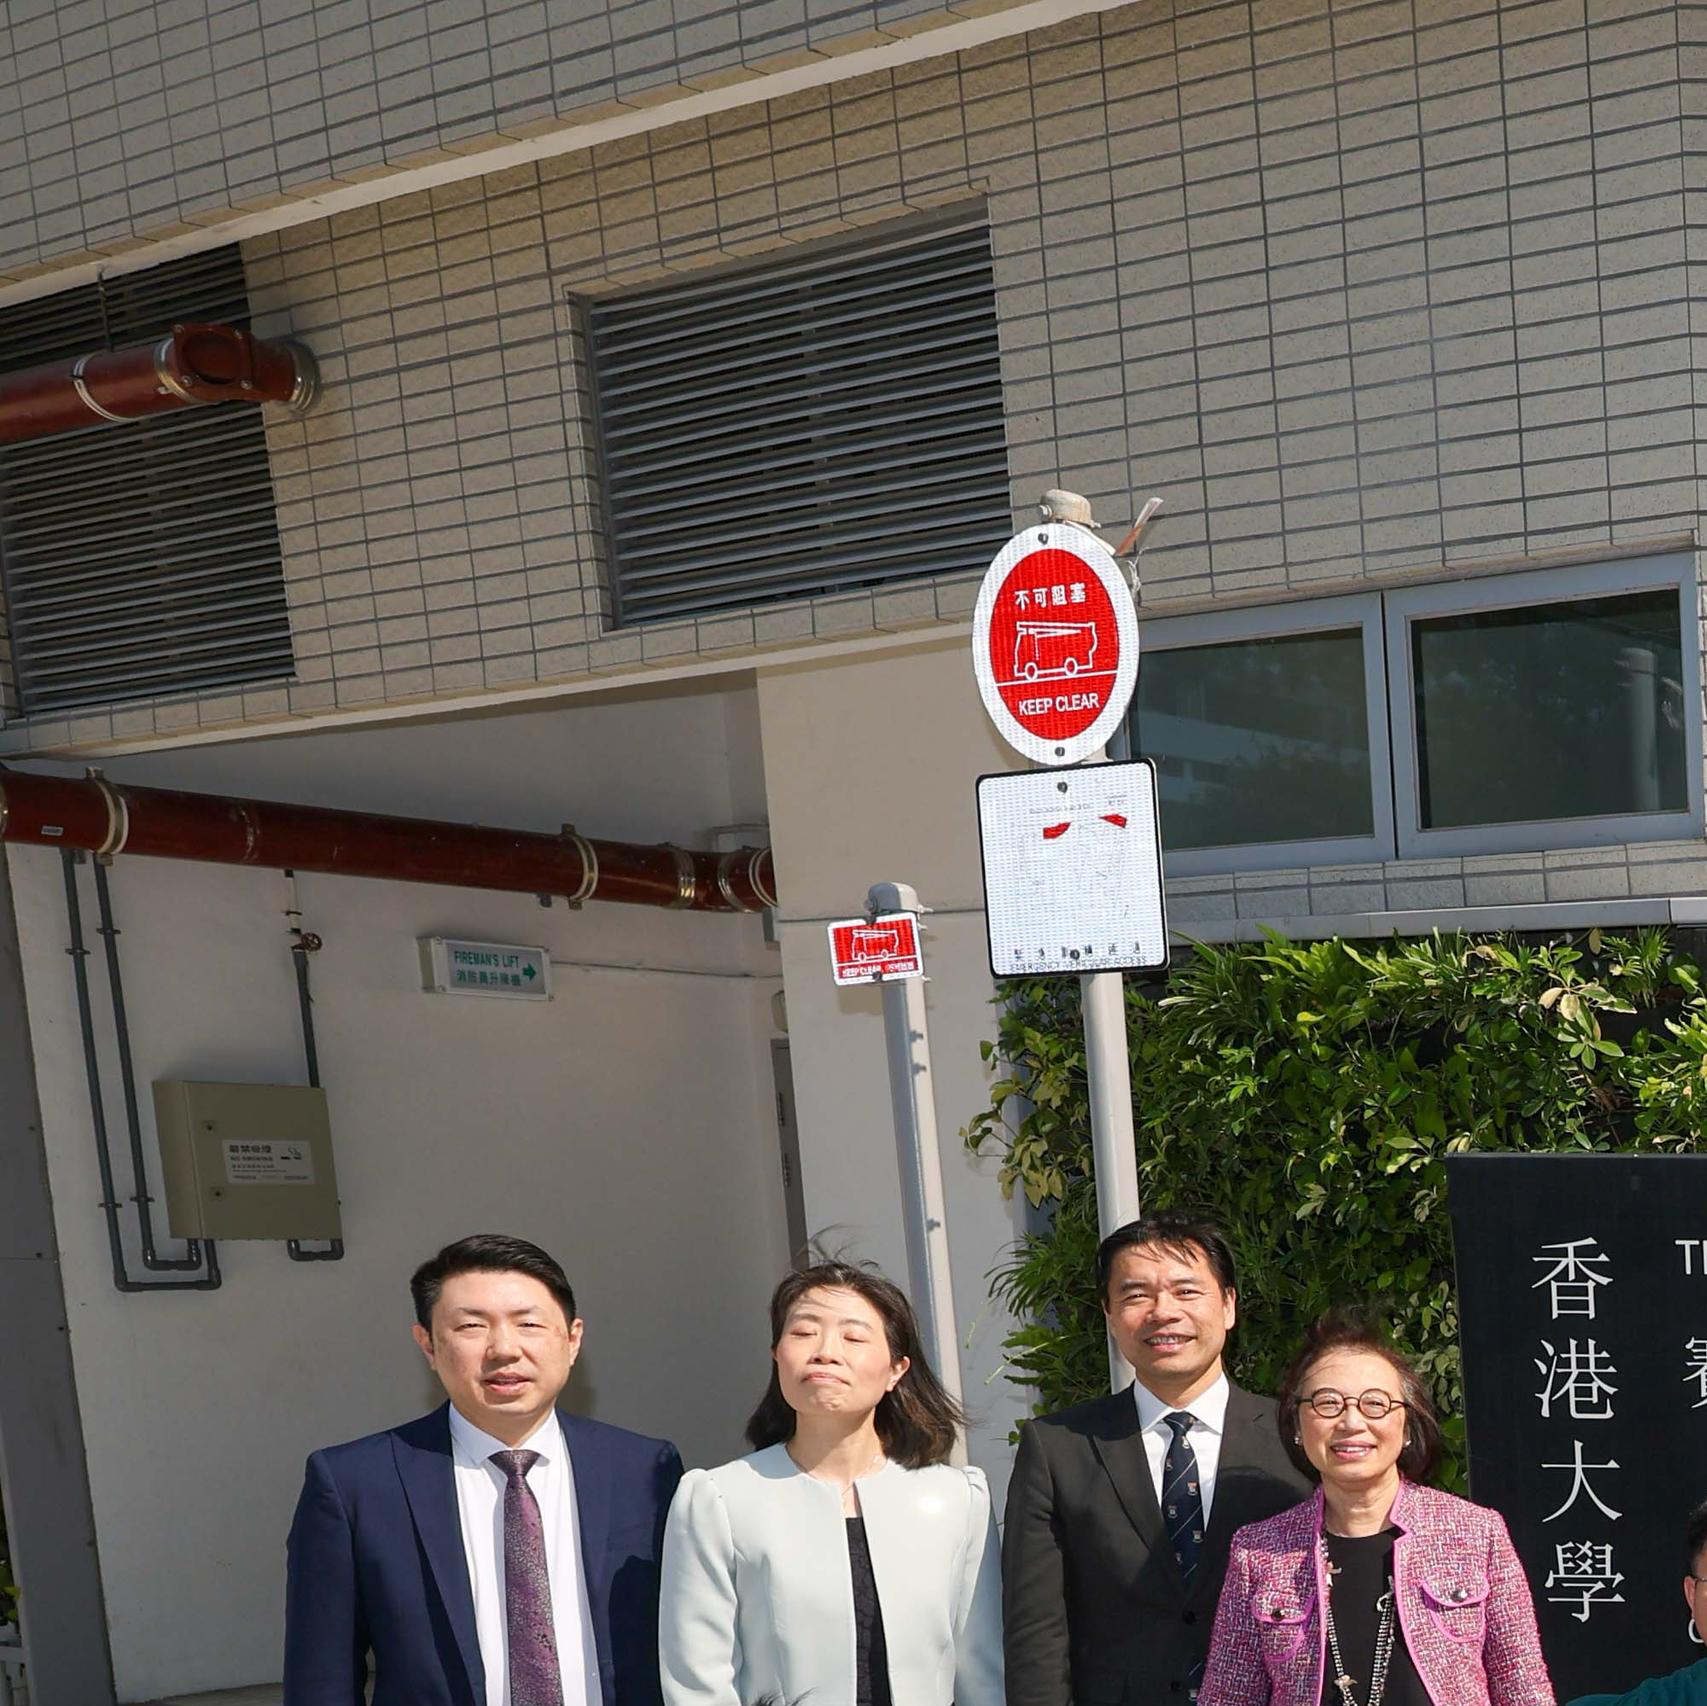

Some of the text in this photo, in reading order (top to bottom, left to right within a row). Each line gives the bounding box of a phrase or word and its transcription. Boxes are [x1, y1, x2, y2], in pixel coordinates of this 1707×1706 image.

[1014, 582, 1086, 611] 不可阻塞
[1019, 692, 1100, 716] KEEP CLEAR
[454, 951, 519, 968] FIREMAN'S LIFT
[1531, 1237, 1626, 1623] 香港大學
